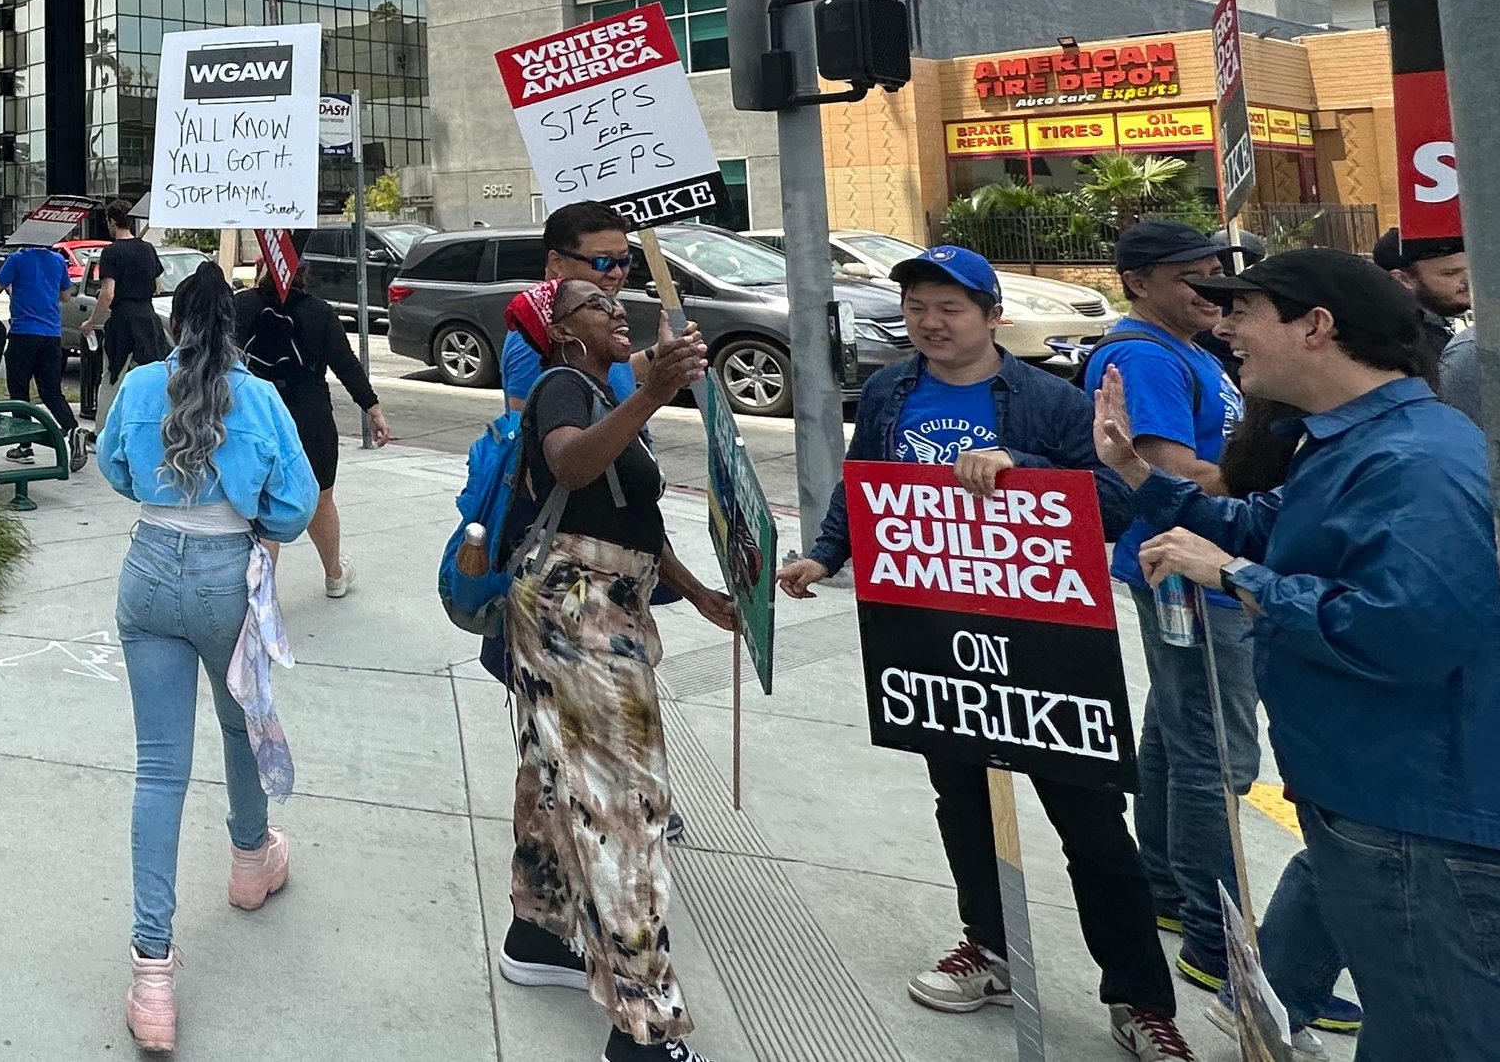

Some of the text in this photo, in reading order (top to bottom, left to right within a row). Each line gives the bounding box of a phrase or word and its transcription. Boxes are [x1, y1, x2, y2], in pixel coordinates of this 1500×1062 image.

[511, 14, 649, 67] WRITERS
[190, 60, 289, 83] WGAW
[522, 35, 647, 80] GUILD OF
[522, 46, 663, 99] AMERICA
[973, 42, 1176, 80] AMERICAN
[974, 65, 1176, 98] TIRE DEPOT
[1015, 84, 1179, 108] Auto Care Experts
[319, 104, 350, 116] DASH
[540, 84, 656, 141] STEPS
[1146, 112, 1179, 125] OIL
[175, 107, 224, 148] YALL
[598, 122, 633, 143] FOR
[956, 124, 1011, 137] BRAKE
[956, 136, 1014, 148] REPAIR
[1038, 124, 1104, 139] TIRES
[1125, 124, 1205, 140] CHANGE
[168, 148, 219, 176] YALL
[227, 148, 270, 171] GOT
[555, 143, 676, 193] STEPS
[165, 183, 213, 208] STOP
[483, 184, 512, 198] 5815
[610, 181, 717, 223] RIKE
[33, 209, 84, 222] STRIKE!
[920, 418, 998, 443] GUILD OF
[860, 481, 1072, 528] WRITERS
[875, 517, 1072, 565] GUILD OF
[870, 552, 1096, 607] AMERICA
[952, 630, 1009, 676] ON
[881, 667, 1119, 761] STRIKE
